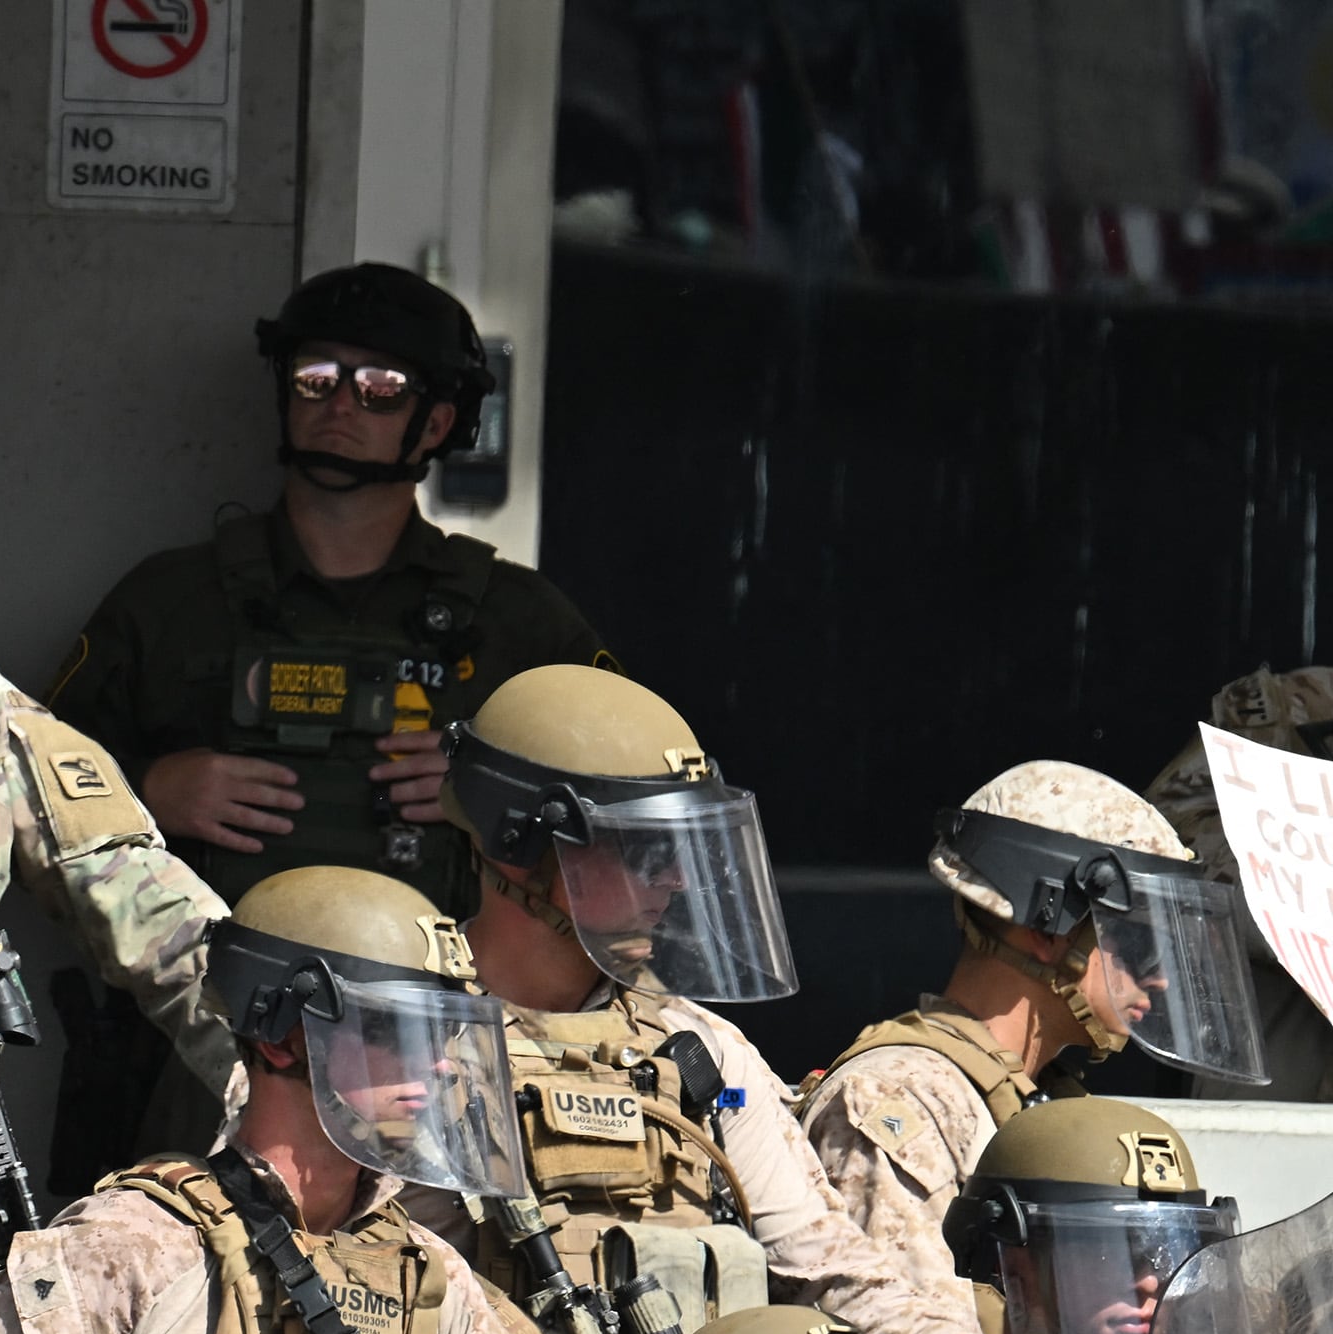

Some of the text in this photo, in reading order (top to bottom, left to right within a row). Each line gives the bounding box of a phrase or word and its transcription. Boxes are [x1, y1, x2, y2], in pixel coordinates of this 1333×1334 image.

[71, 127, 114, 151] NO
[72, 163, 210, 189] SMOKING
[420, 662, 445, 688] 12
[1247, 851, 1306, 913] MY
[555, 1092, 637, 1118] USMC
[332, 1285, 400, 1318] USMC
[340, 1311, 391, 1329] 610393051
